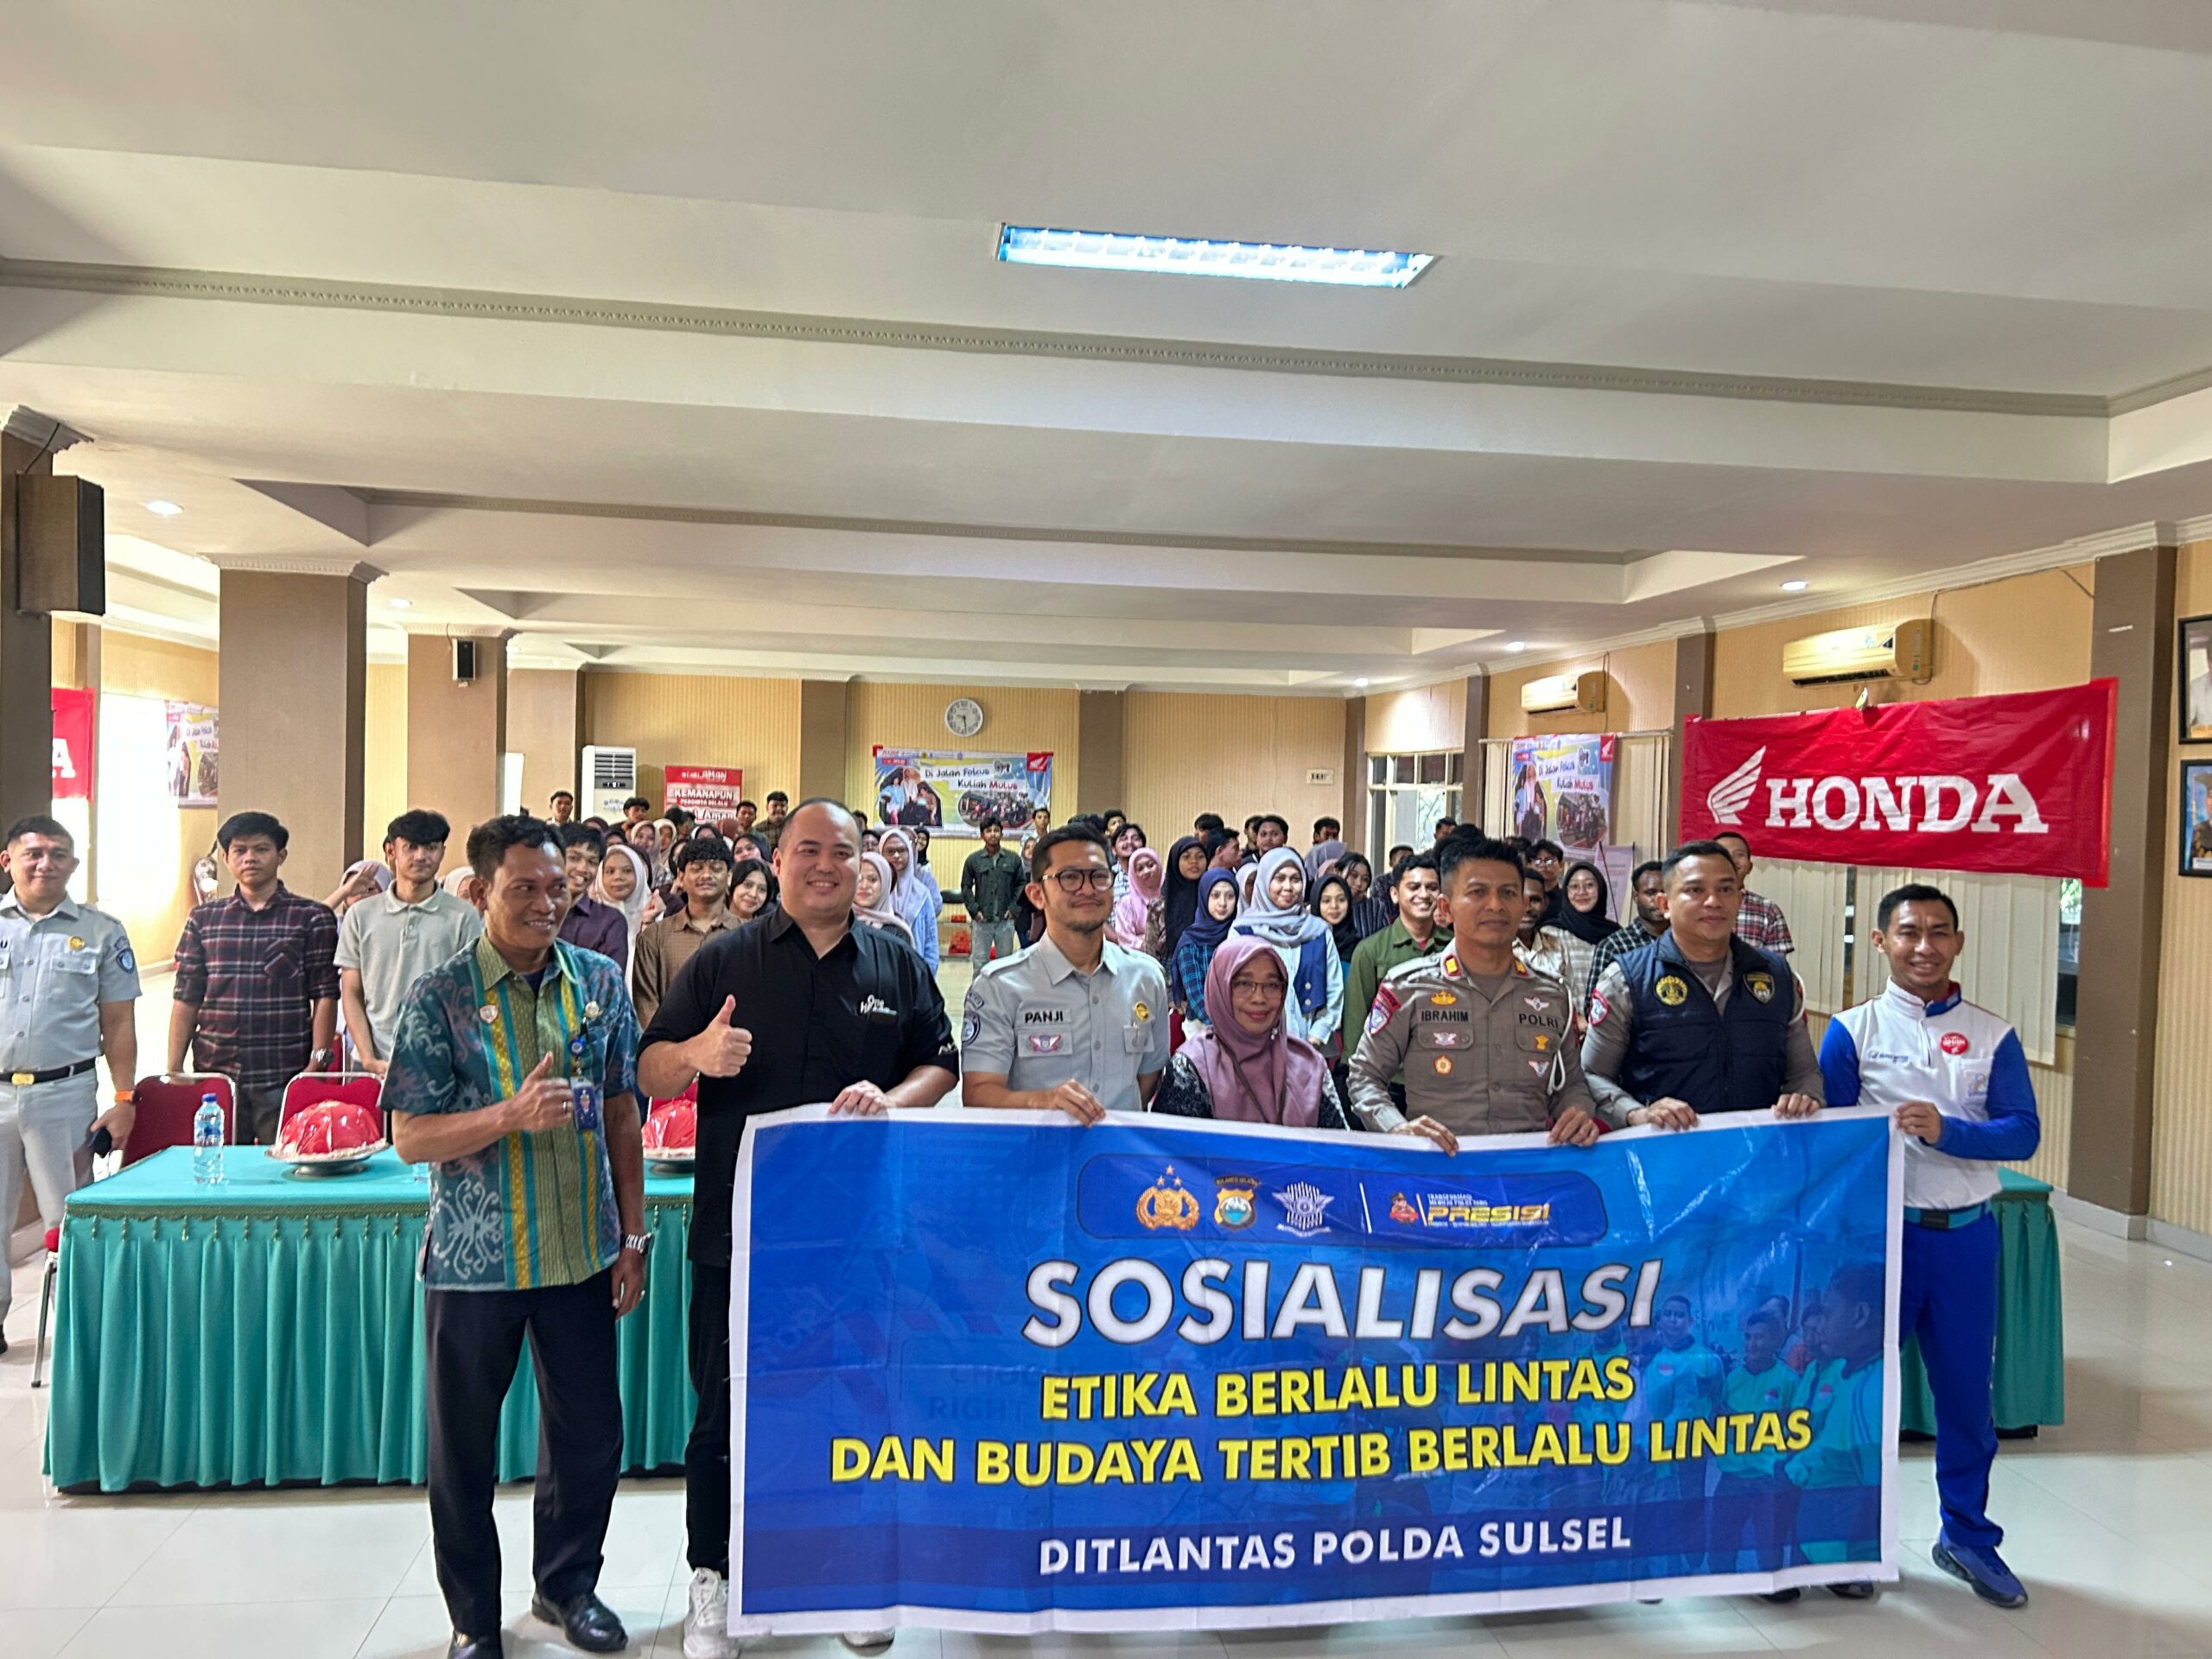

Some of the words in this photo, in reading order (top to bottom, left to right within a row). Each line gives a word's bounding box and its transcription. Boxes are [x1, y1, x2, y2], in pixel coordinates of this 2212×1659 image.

[925, 768, 933, 778] Di
[936, 768, 961, 778] Jalan
[957, 779, 986, 788] Kuliah
[675, 788, 734, 800] KEMANAPUN
[1765, 773, 2049, 834] HONDA
[1025, 1010, 1064, 1024] PANJI
[1421, 1009, 1469, 1023] IBRAHIM
[1519, 1013, 1559, 1028] POLRI
[1427, 1203, 1550, 1223] PRESISI
[1022, 1258, 1662, 1348] SOSIALISASI
[1041, 1372, 1198, 1421] ETIKA
[1216, 1363, 1438, 1418] BERLALU
[1457, 1357, 1635, 1405] LINTAS
[830, 1435, 954, 1483] DAN
[976, 1438, 1203, 1486] BUDAYA
[1217, 1432, 1391, 1481] TERTIB
[1409, 1422, 1630, 1473] BERLALU
[1649, 1408, 1811, 1463] LINTAS
[1039, 1532, 1295, 1575] DITLANTAS
[1313, 1525, 1465, 1565] POLDA
[1478, 1517, 1630, 1556] SULSEL
